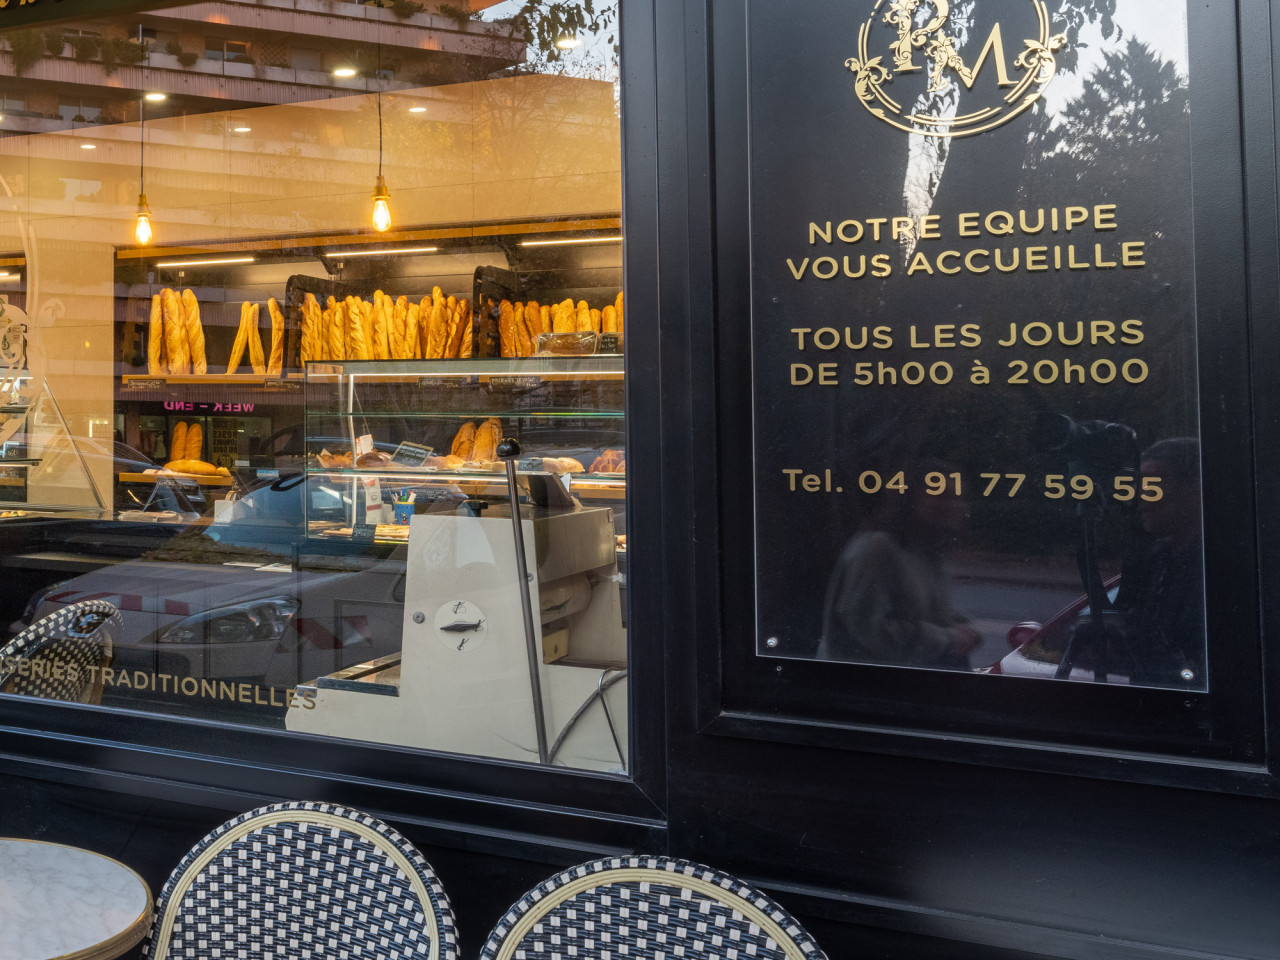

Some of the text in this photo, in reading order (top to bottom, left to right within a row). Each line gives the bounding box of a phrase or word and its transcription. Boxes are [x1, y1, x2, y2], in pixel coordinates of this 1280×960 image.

[808, 204, 1118, 244] NOTRE EQUIPE
[786, 241, 1147, 281] VOUS ACCUEILLE
[791, 319, 1145, 351] TOUS LES JOURS
[790, 358, 1150, 386] DE 5h00 à 20h00
[782, 469, 1164, 502] Tel. 04 91 77 59 55
[86, 664, 317, 711] TRADITIONNELLES
